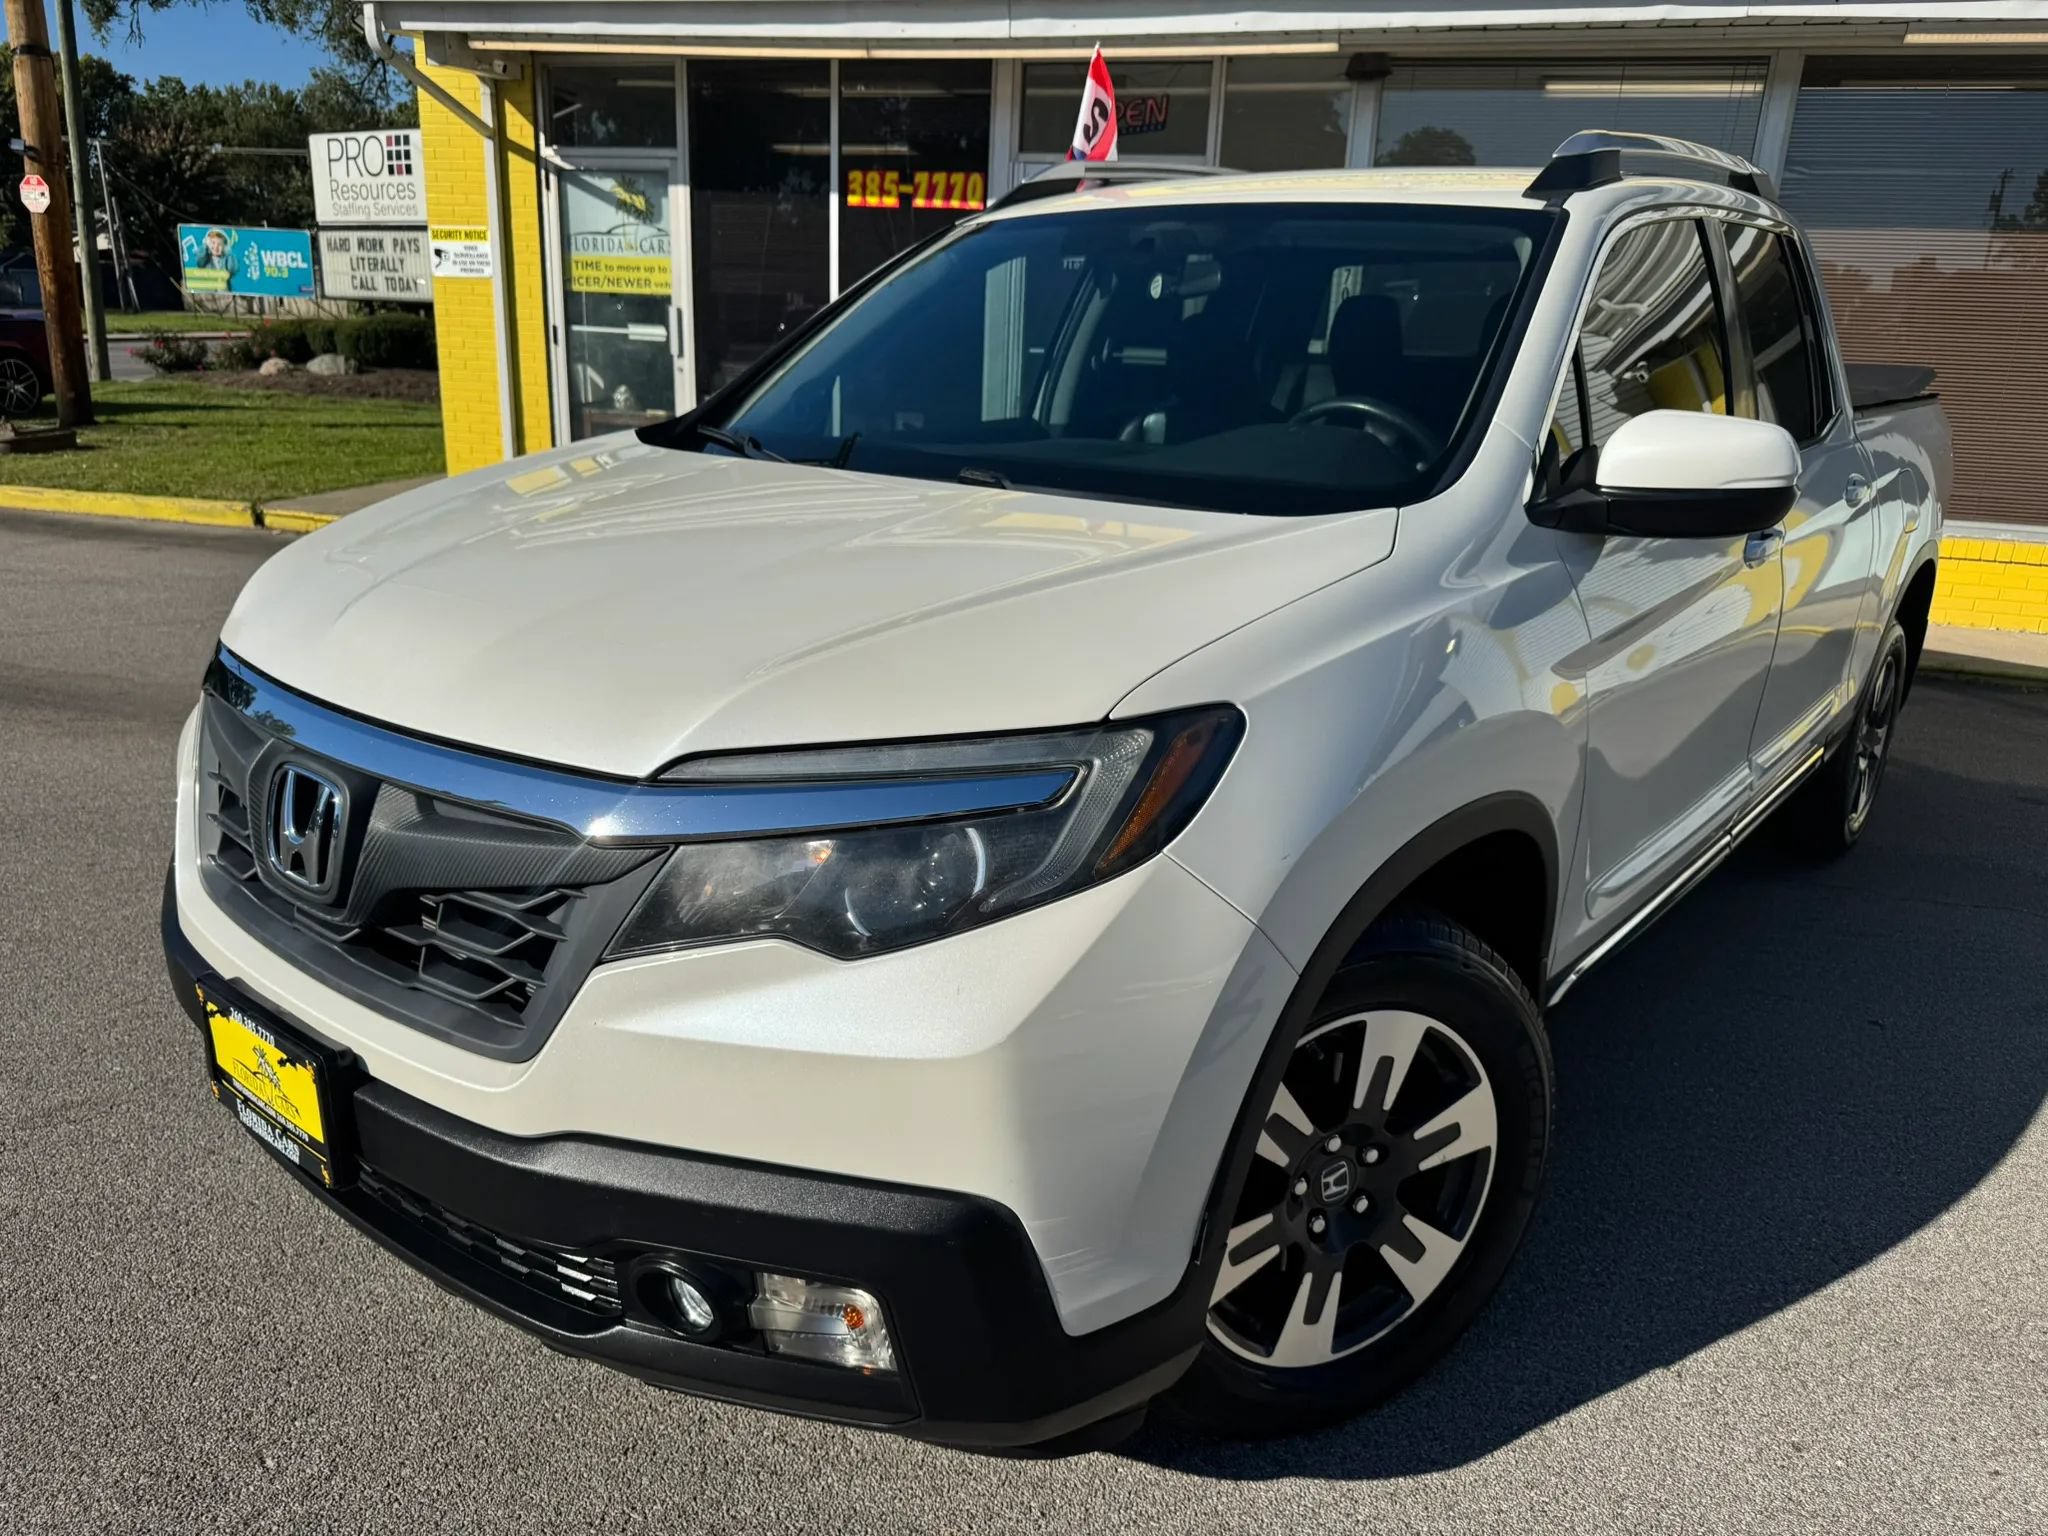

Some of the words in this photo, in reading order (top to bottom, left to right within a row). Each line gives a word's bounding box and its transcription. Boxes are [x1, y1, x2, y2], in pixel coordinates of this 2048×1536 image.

[327, 135, 385, 178] PRO
[330, 179, 416, 201] Resources
[848, 170, 984, 210] 385-7770
[332, 202, 371, 220] Staffing
[373, 201, 418, 217] Services
[431, 230, 462, 241] SECURITY
[464, 230, 488, 241] NOTICE
[574, 234, 624, 253] LORIDA
[326, 237, 351, 252] HARD
[357, 238, 385, 253] WORK
[393, 238, 420, 254] PAYS
[261, 250, 308, 268] WBCL
[350, 257, 404, 272] LITERALLY
[574, 260, 602, 272] TIME
[604, 263, 615, 273] to
[616, 264, 641, 274] move
[643, 264, 656, 275] up
[658, 264, 668, 274] to
[351, 276, 377, 291] CALL
[384, 277, 419, 293] TODAY
[236, 1098, 274, 1140] FLORIDA
[275, 1128, 300, 1157] CARS
